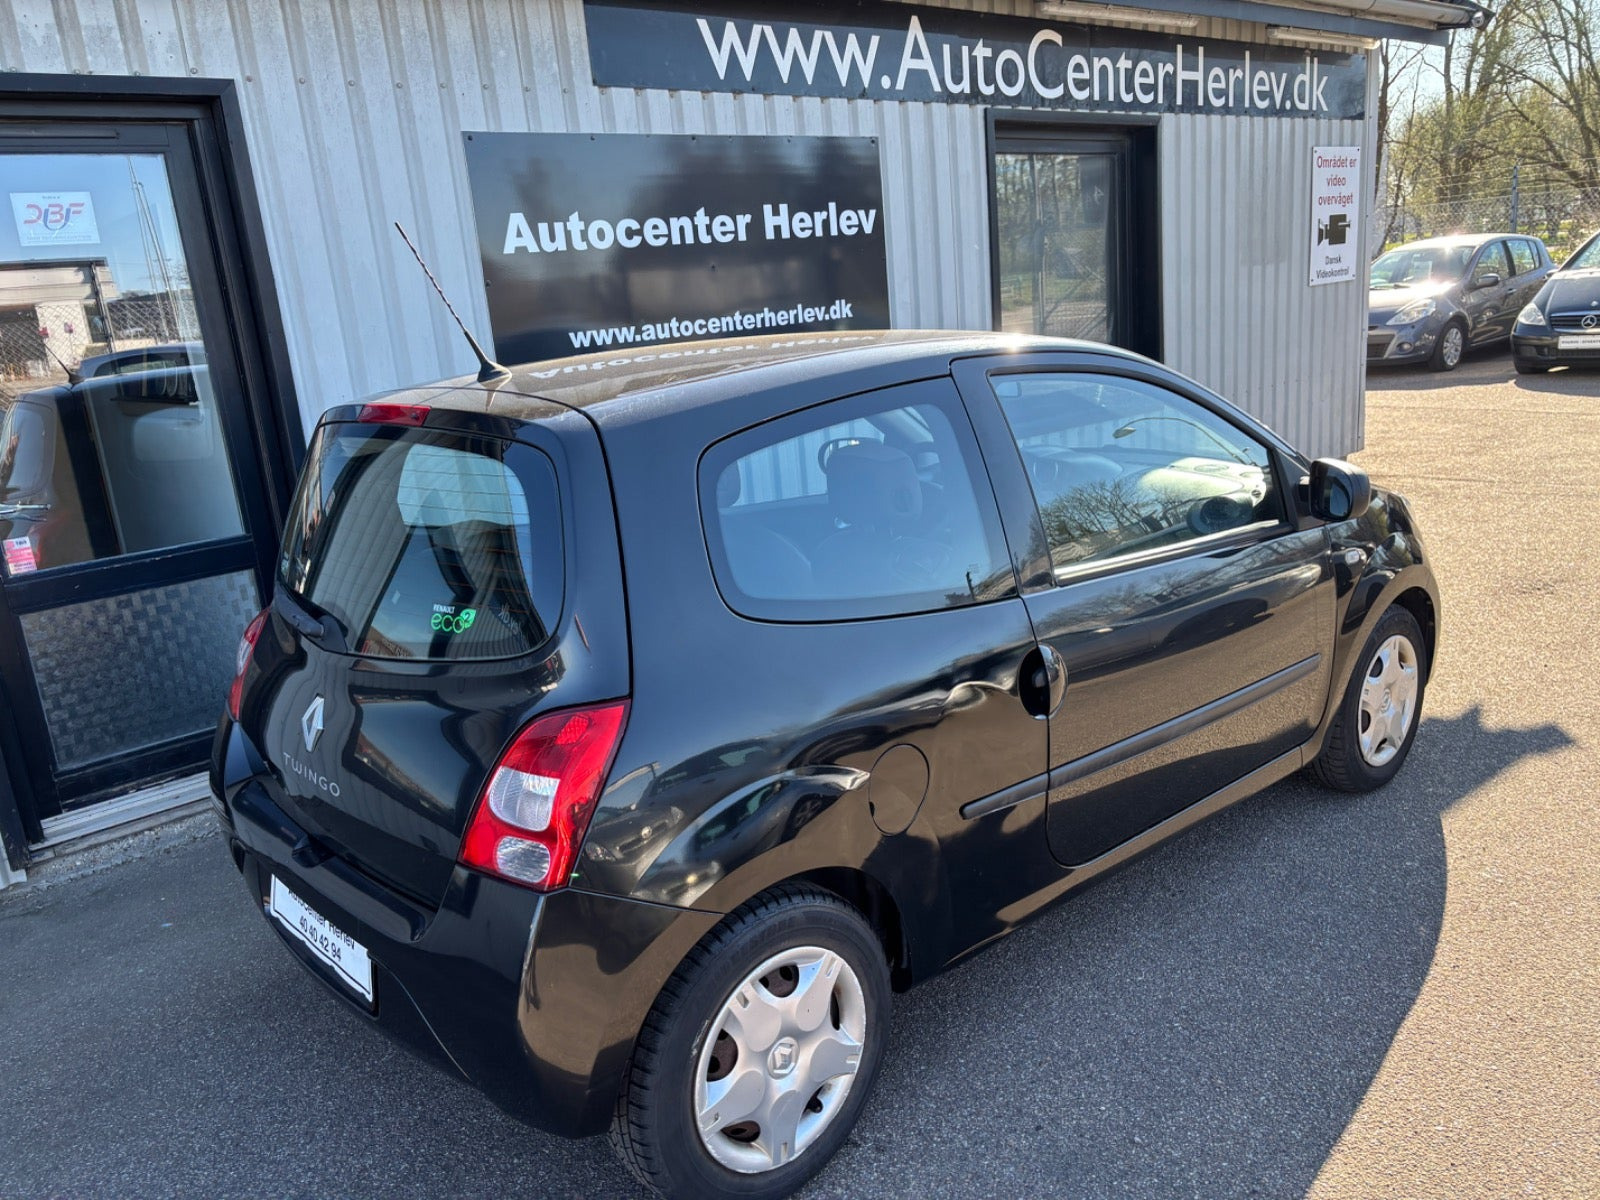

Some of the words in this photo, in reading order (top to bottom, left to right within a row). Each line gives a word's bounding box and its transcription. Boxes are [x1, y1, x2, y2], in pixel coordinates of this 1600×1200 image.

[1316, 155, 1348, 168] Området
[1349, 158, 1357, 168] er
[1326, 174, 1347, 187] video
[1317, 192, 1354, 207] overvåget
[503, 207, 752, 255] Autocenter
[762, 201, 876, 241] Herlev
[1325, 253, 1342, 265] Dansk
[1315, 266, 1350, 279] Videokontrol
[568, 299, 853, 348] www.autocenterherlev.dk
[433, 604, 455, 614] RENAULT
[283, 752, 340, 797] TWINGO
[300, 916, 307, 933] 40
[309, 925, 317, 942] 40
[319, 935, 329, 952] 42
[331, 942, 341, 961] 94
